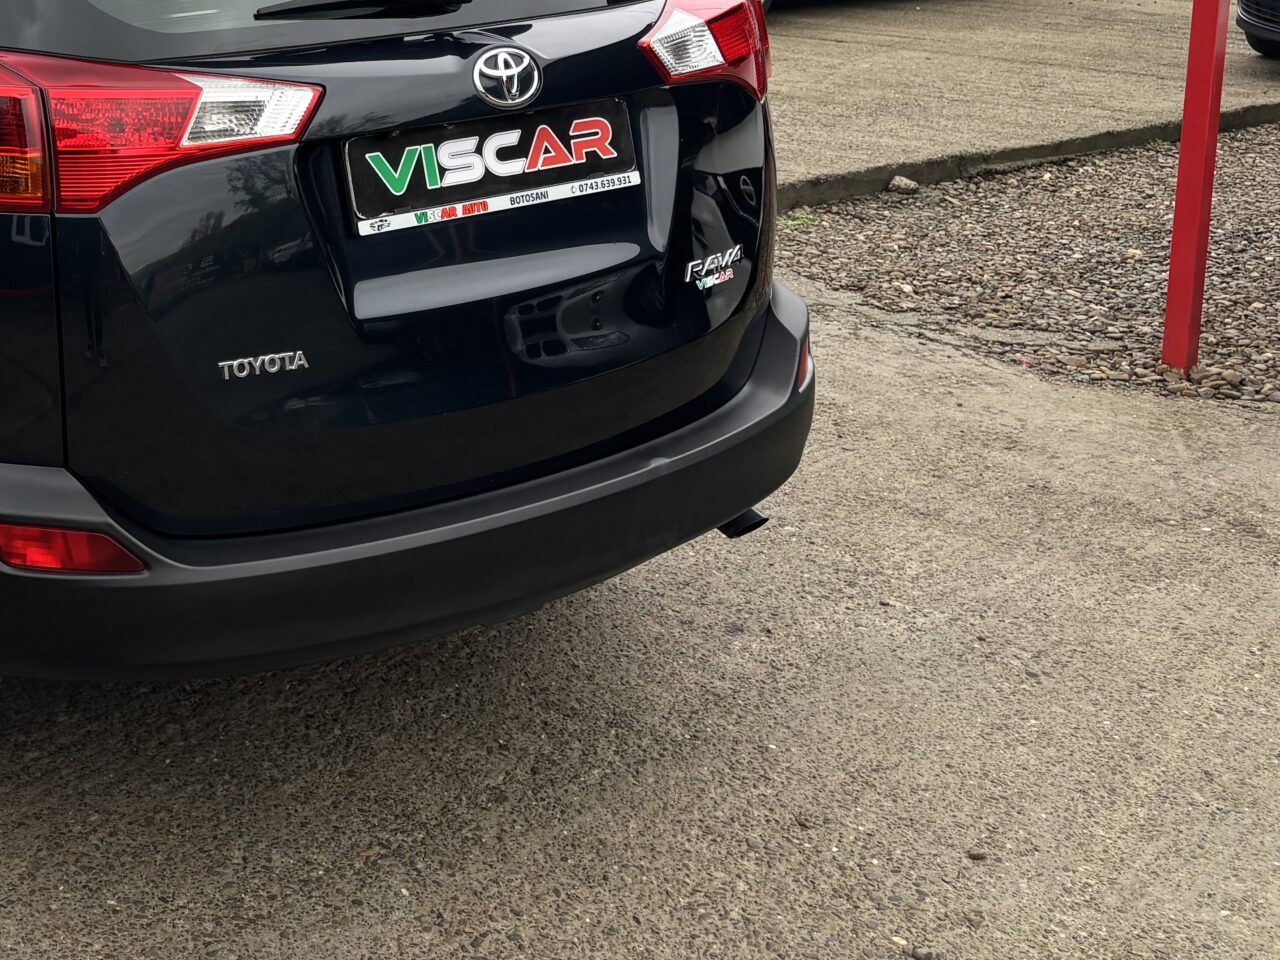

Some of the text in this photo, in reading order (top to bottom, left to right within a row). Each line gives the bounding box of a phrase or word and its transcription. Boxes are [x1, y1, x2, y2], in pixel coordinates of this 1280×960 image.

[365, 116, 617, 196] VISCAR
[414, 175, 632, 224] VISCAR AUTO BOTOSANI 0743.639.931
[695, 268, 734, 290] VISCAR
[218, 350, 309, 380] TOYOTA
